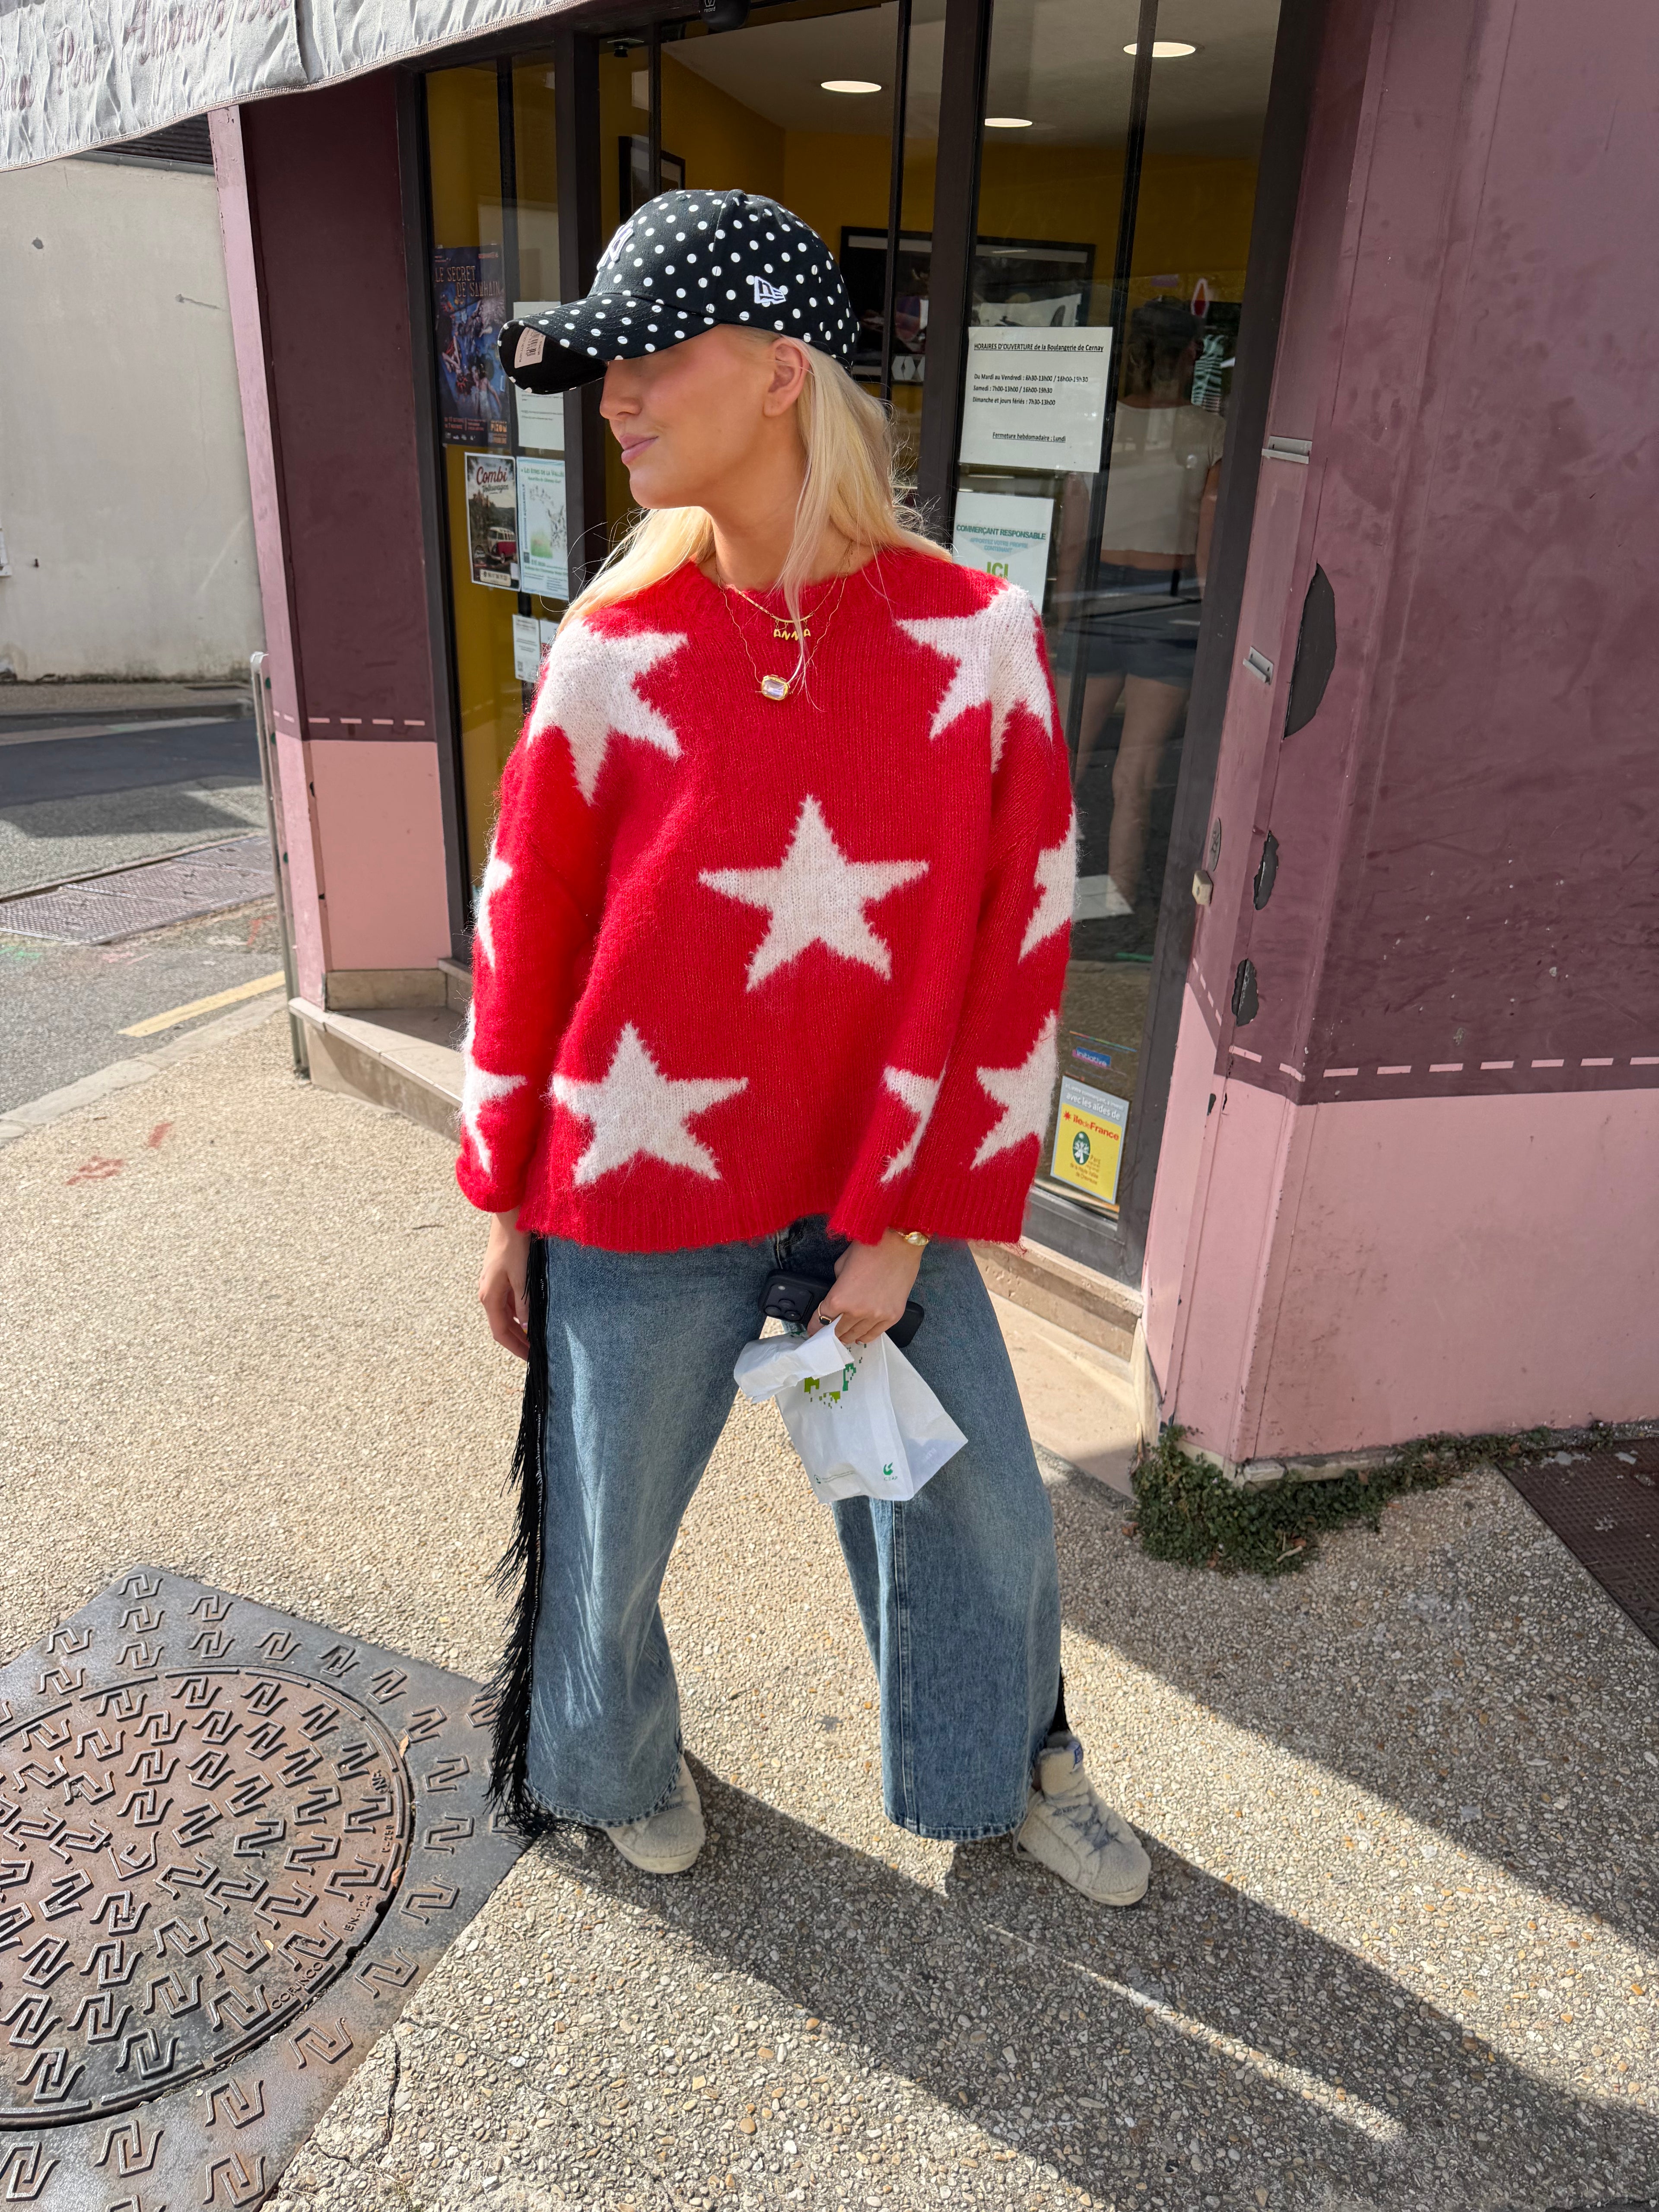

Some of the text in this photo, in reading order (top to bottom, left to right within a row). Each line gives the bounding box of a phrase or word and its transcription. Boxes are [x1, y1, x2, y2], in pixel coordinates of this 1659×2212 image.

[447, 266, 475, 281] SECRET
[456, 282, 467, 297] DE
[1017, 433, 1049, 442] hebdomadaire
[477, 466, 508, 486] Combi
[956, 524, 1046, 540] COMMERÇANT RESPONSABLE
[987, 562, 1008, 578] ICI
[1066, 1093, 1121, 1120] avec les aides de
[344, 1894, 373, 1932] EN-124
[271, 1961, 324, 2010] COFUNCO
